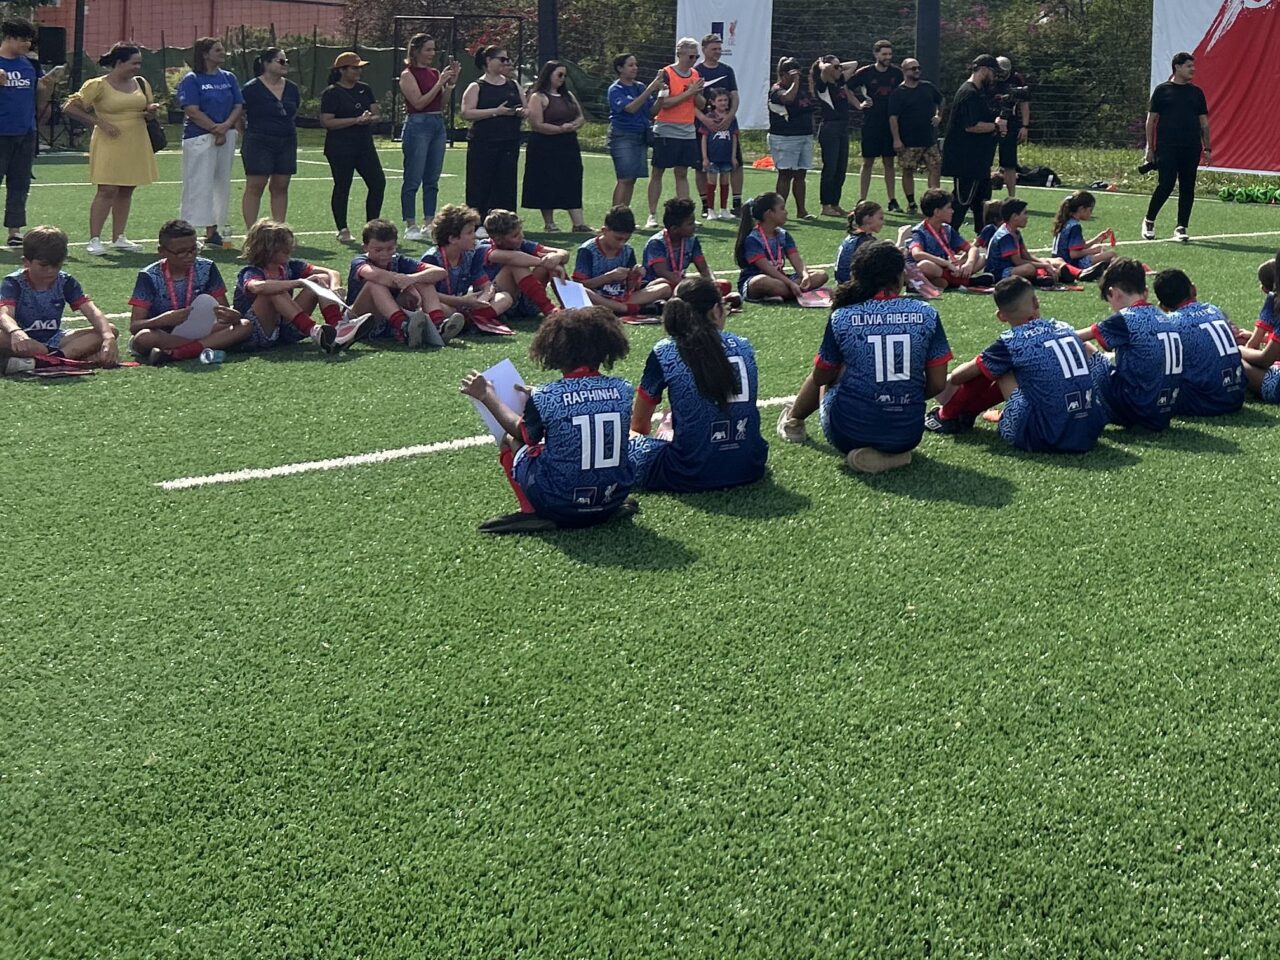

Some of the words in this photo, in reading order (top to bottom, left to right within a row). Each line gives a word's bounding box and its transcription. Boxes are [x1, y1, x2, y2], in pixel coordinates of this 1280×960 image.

[6, 71, 21, 80] 10
[851, 312, 883, 326] OLÍVIA
[886, 312, 923, 324] RIBEIRO
[1199, 320, 1239, 357] 10
[867, 334, 911, 383] 10
[1044, 336, 1090, 379] 10
[1157, 332, 1183, 375] 10
[563, 387, 621, 406] RAPHINHA
[572, 412, 622, 471] 10
